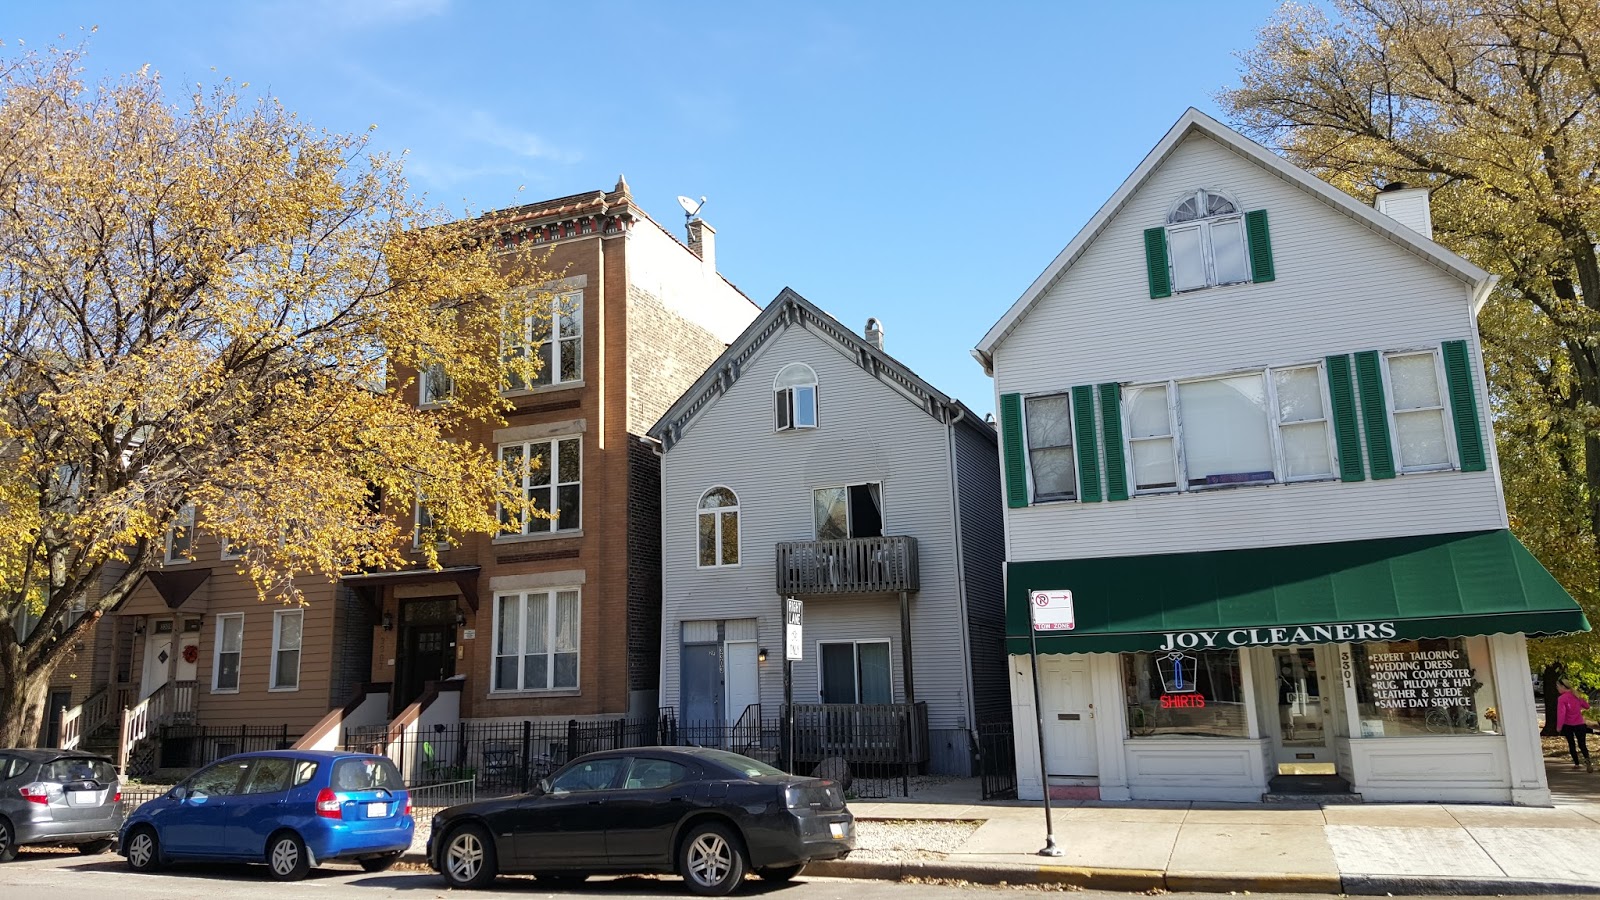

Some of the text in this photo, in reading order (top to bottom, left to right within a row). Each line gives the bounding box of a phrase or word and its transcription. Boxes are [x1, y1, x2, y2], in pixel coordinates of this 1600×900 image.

[789, 600, 801, 613] RIGHT
[789, 612, 801, 625] LANE
[1160, 622, 1397, 650] JOY CLEANERS
[1373, 650, 1459, 662] EXPERT TAILORING
[1341, 652, 1351, 688] 3301
[1375, 660, 1453, 671] WEDDING DRESS
[1376, 669, 1470, 680] DOWN COMFORTER
[1404, 680, 1438, 689] PILLOW
[1443, 679, 1450, 688] &
[1454, 678, 1471, 687] HAT
[1378, 688, 1462, 699] LEATHER & SUEDE
[1160, 694, 1205, 709] SHIRTS
[1380, 697, 1471, 709] SAME DAY SERVICE
